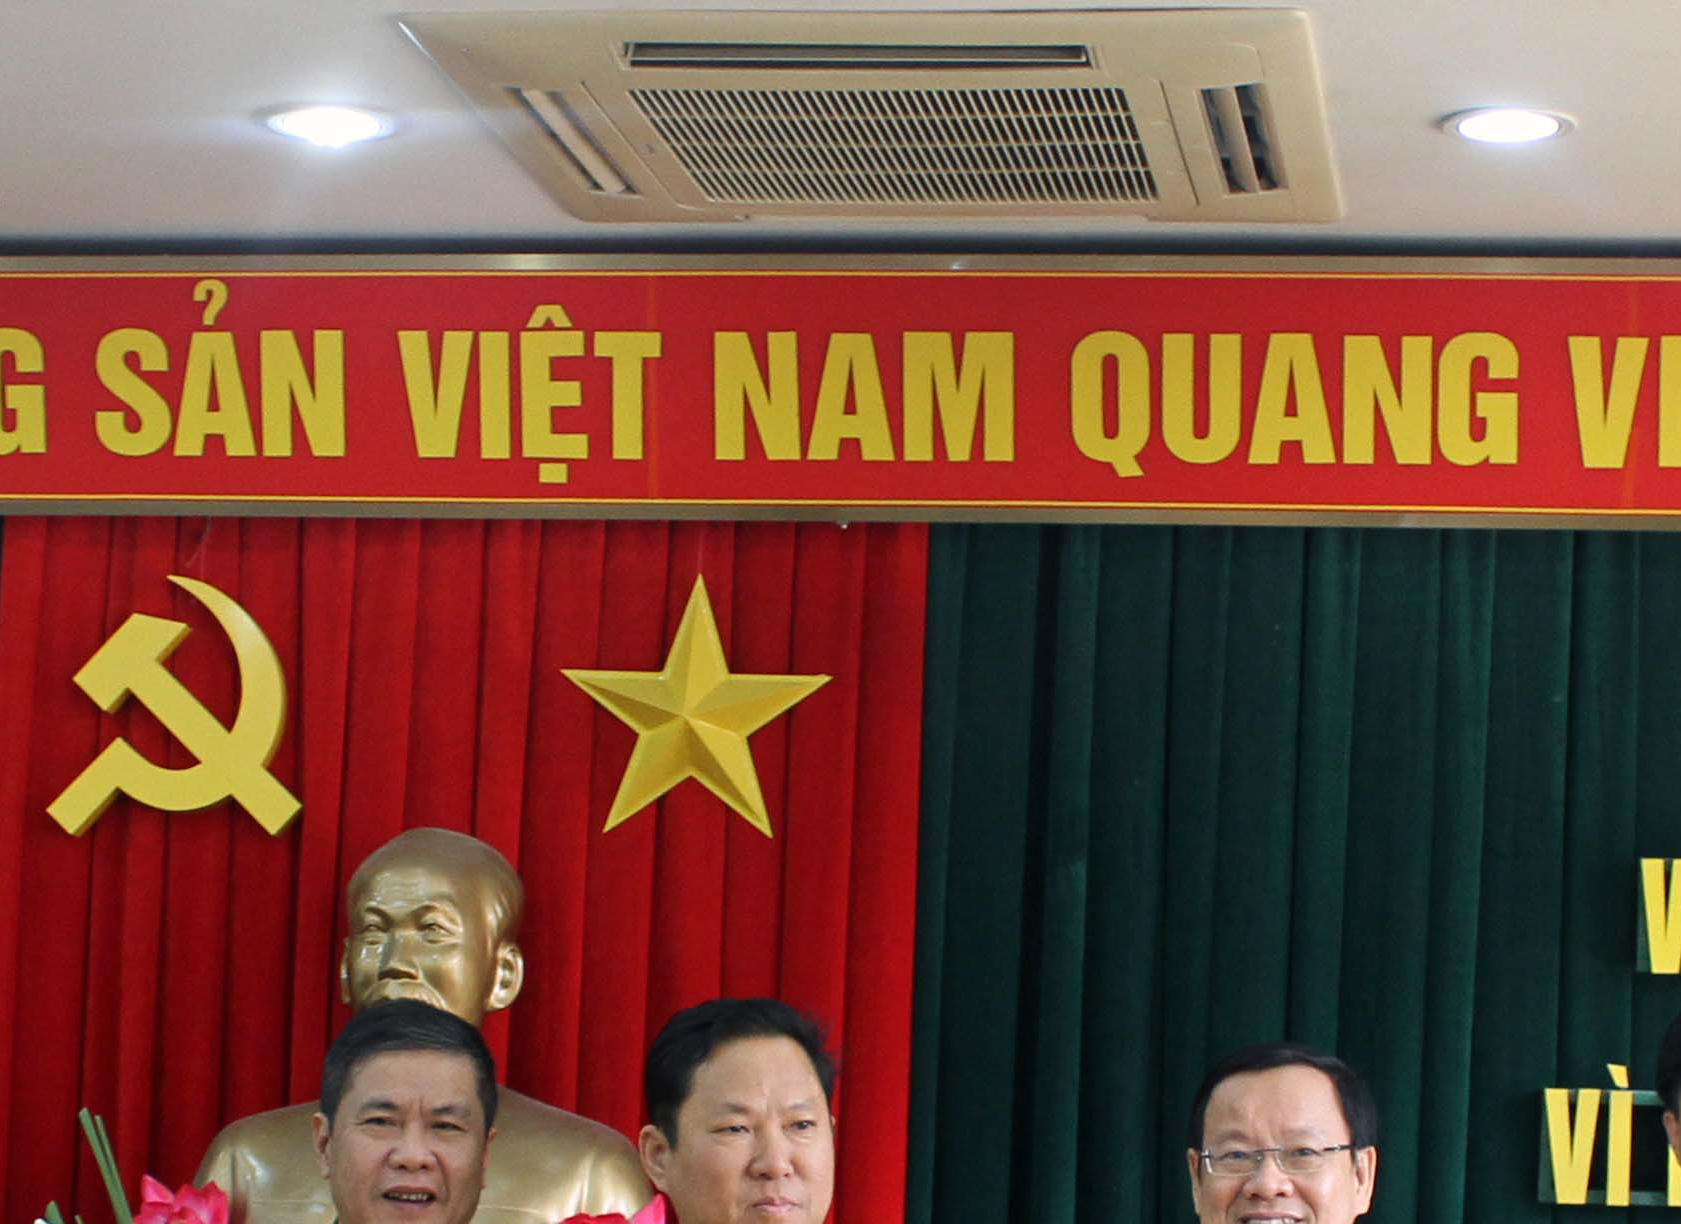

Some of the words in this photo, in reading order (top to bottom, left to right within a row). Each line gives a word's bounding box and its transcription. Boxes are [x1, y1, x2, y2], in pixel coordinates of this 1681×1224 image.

[95, 280, 346, 457] SẢN
[398, 306, 662, 484] VIỆT
[714, 331, 1014, 461] NAM
[1070, 331, 1520, 477] QUANG
[1545, 1064, 1634, 1207] VÌ
